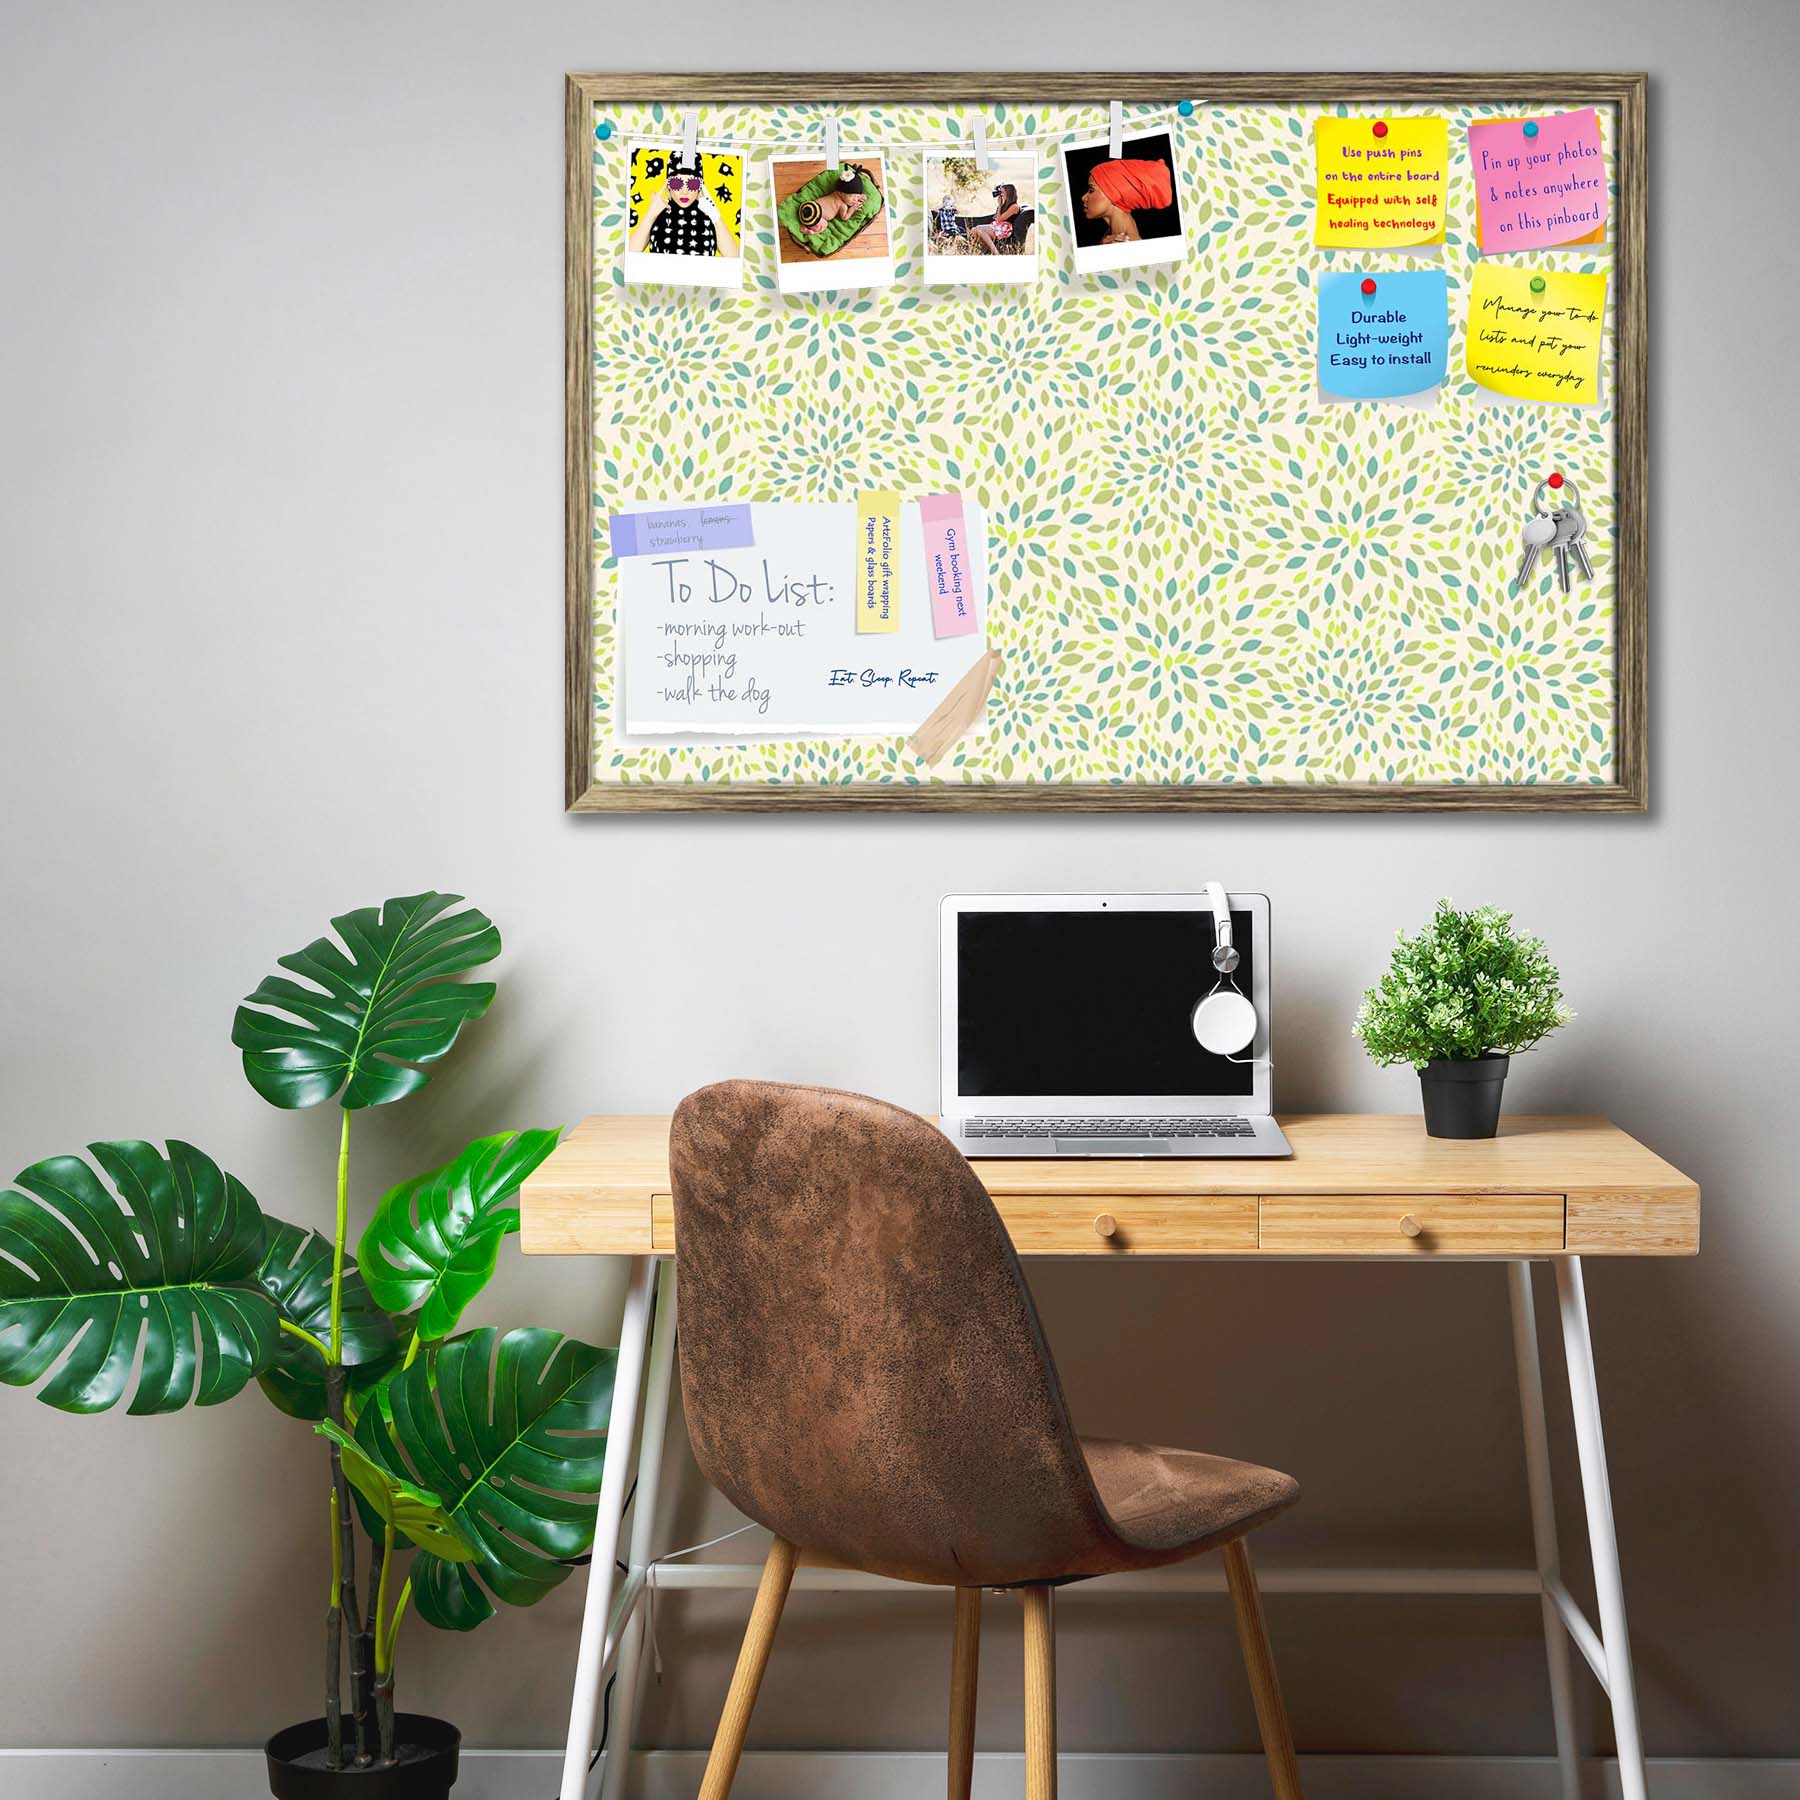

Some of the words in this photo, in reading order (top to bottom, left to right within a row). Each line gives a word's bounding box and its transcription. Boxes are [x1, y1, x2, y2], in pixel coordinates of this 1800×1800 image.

[1342, 146, 1362, 158] Use
[1367, 148, 1396, 161] push
[1400, 148, 1422, 161] pins
[1482, 150, 1502, 171] Pin
[1507, 158, 1520, 171] up
[1526, 153, 1551, 169] your
[1558, 140, 1598, 165] photos
[1342, 171, 1363, 182] the
[1368, 171, 1402, 181] entire
[1407, 170, 1440, 181] board
[1490, 187, 1498, 202] &
[1504, 181, 1537, 200] notes
[1543, 173, 1599, 198] anywhere
[1327, 193, 1379, 208] Equipped
[1384, 195, 1411, 206] with
[1416, 194, 1438, 207] self
[1329, 218, 1369, 231] healing
[1373, 218, 1436, 231] technology
[1500, 222, 1513, 233] on
[1518, 212, 1541, 230] this
[1547, 202, 1599, 231] pinboard
[1351, 310, 1408, 324] Durable
[1483, 295, 1536, 319] Manage
[1539, 310, 1565, 322] your
[1336, 331, 1423, 348] Light-weight
[1511, 335, 1537, 347] and
[1537, 336, 1563, 353] put
[1560, 344, 1586, 356] your
[1330, 353, 1367, 369] Easy
[1372, 354, 1386, 365] to
[1389, 351, 1432, 365] install
[1475, 364, 1533, 377] reminders
[1537, 370, 1585, 389] everyday
[649, 529, 704, 549] strawberry
[865, 517, 876, 545] Papers
[882, 516, 892, 560] ArtzFolio
[945, 528, 956, 551] Gym
[867, 547, 876, 555] &
[865, 557, 877, 578] glass
[880, 561, 893, 577] gift
[935, 554, 949, 595] weekend
[950, 553, 963, 594] booking
[651, 559, 692, 603] To
[704, 559, 752, 603] Do
[763, 559, 834, 607] List:
[867, 580, 877, 609] boards
[880, 580, 891, 619] wrapping
[956, 596, 967, 617] next
[732, 611, 806, 637] work-out
[707, 674, 737, 702] the
[741, 677, 771, 714] dog
